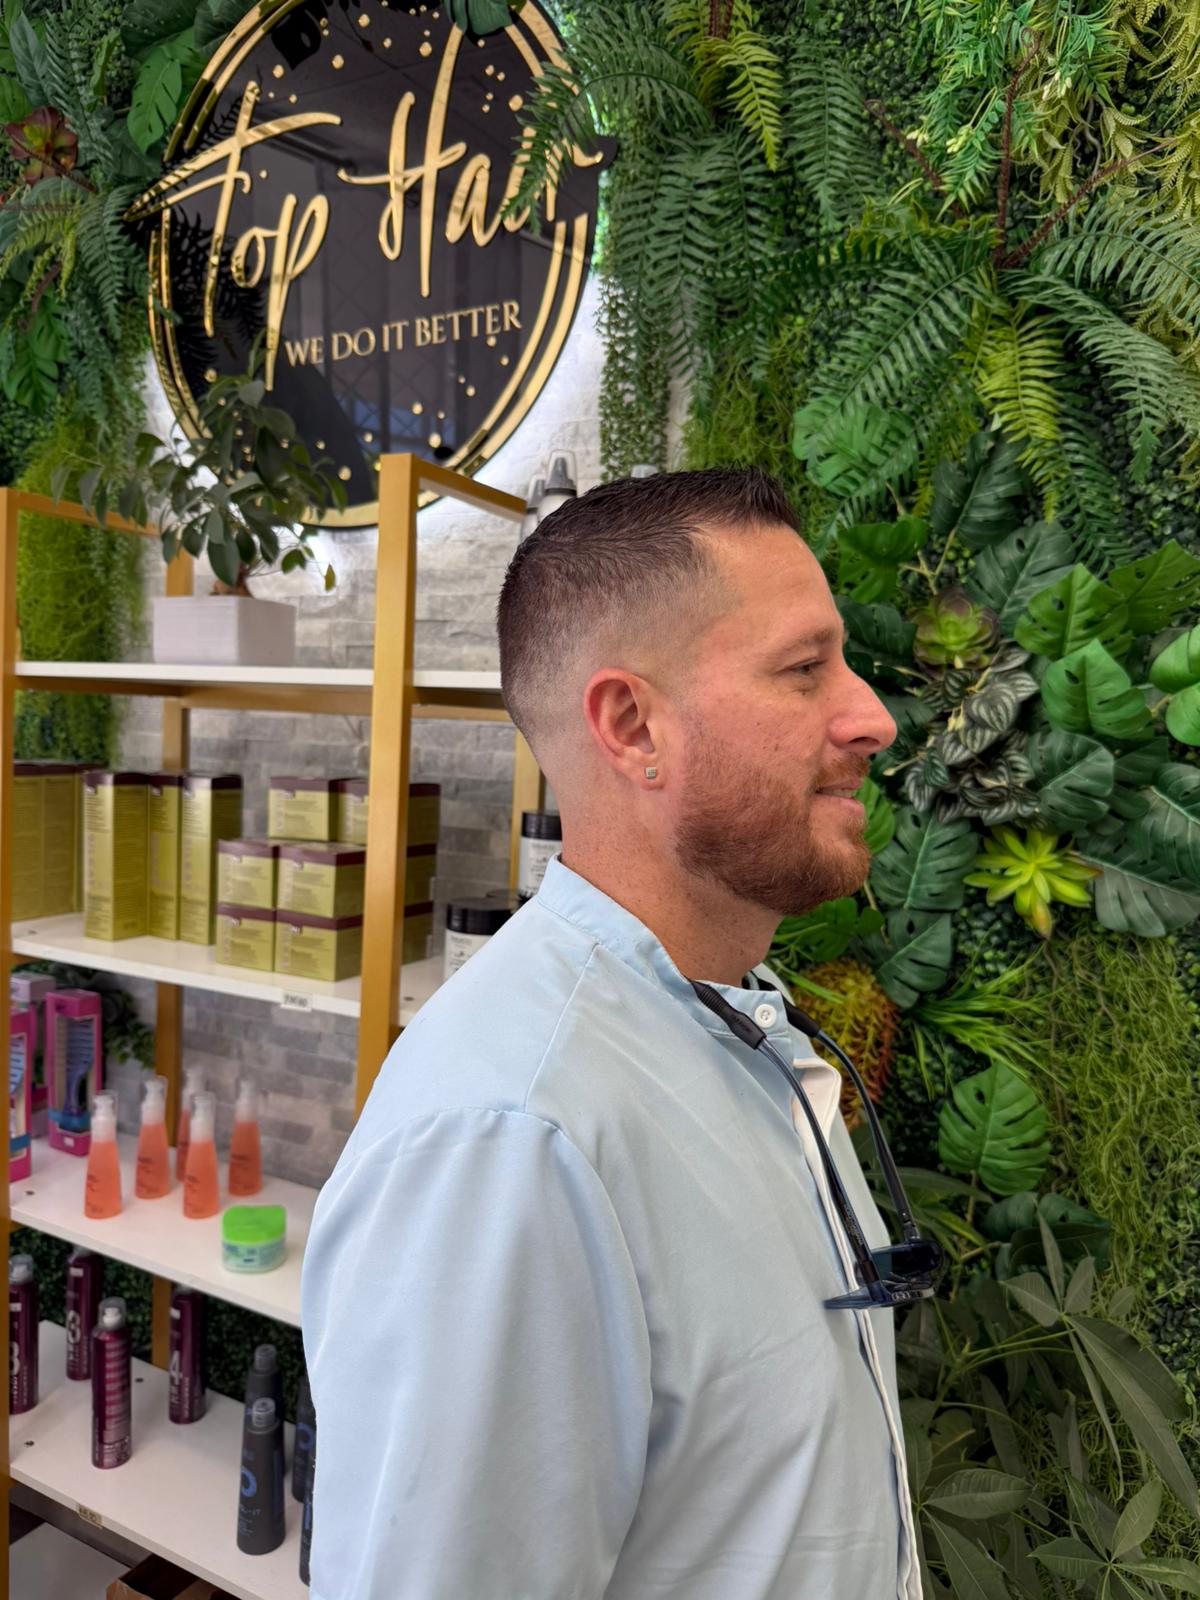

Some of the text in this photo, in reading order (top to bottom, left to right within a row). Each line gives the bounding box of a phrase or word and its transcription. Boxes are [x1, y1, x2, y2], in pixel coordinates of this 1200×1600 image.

[122, 80, 341, 392] Top
[284, 299, 523, 368] WE DO IT BETTER
